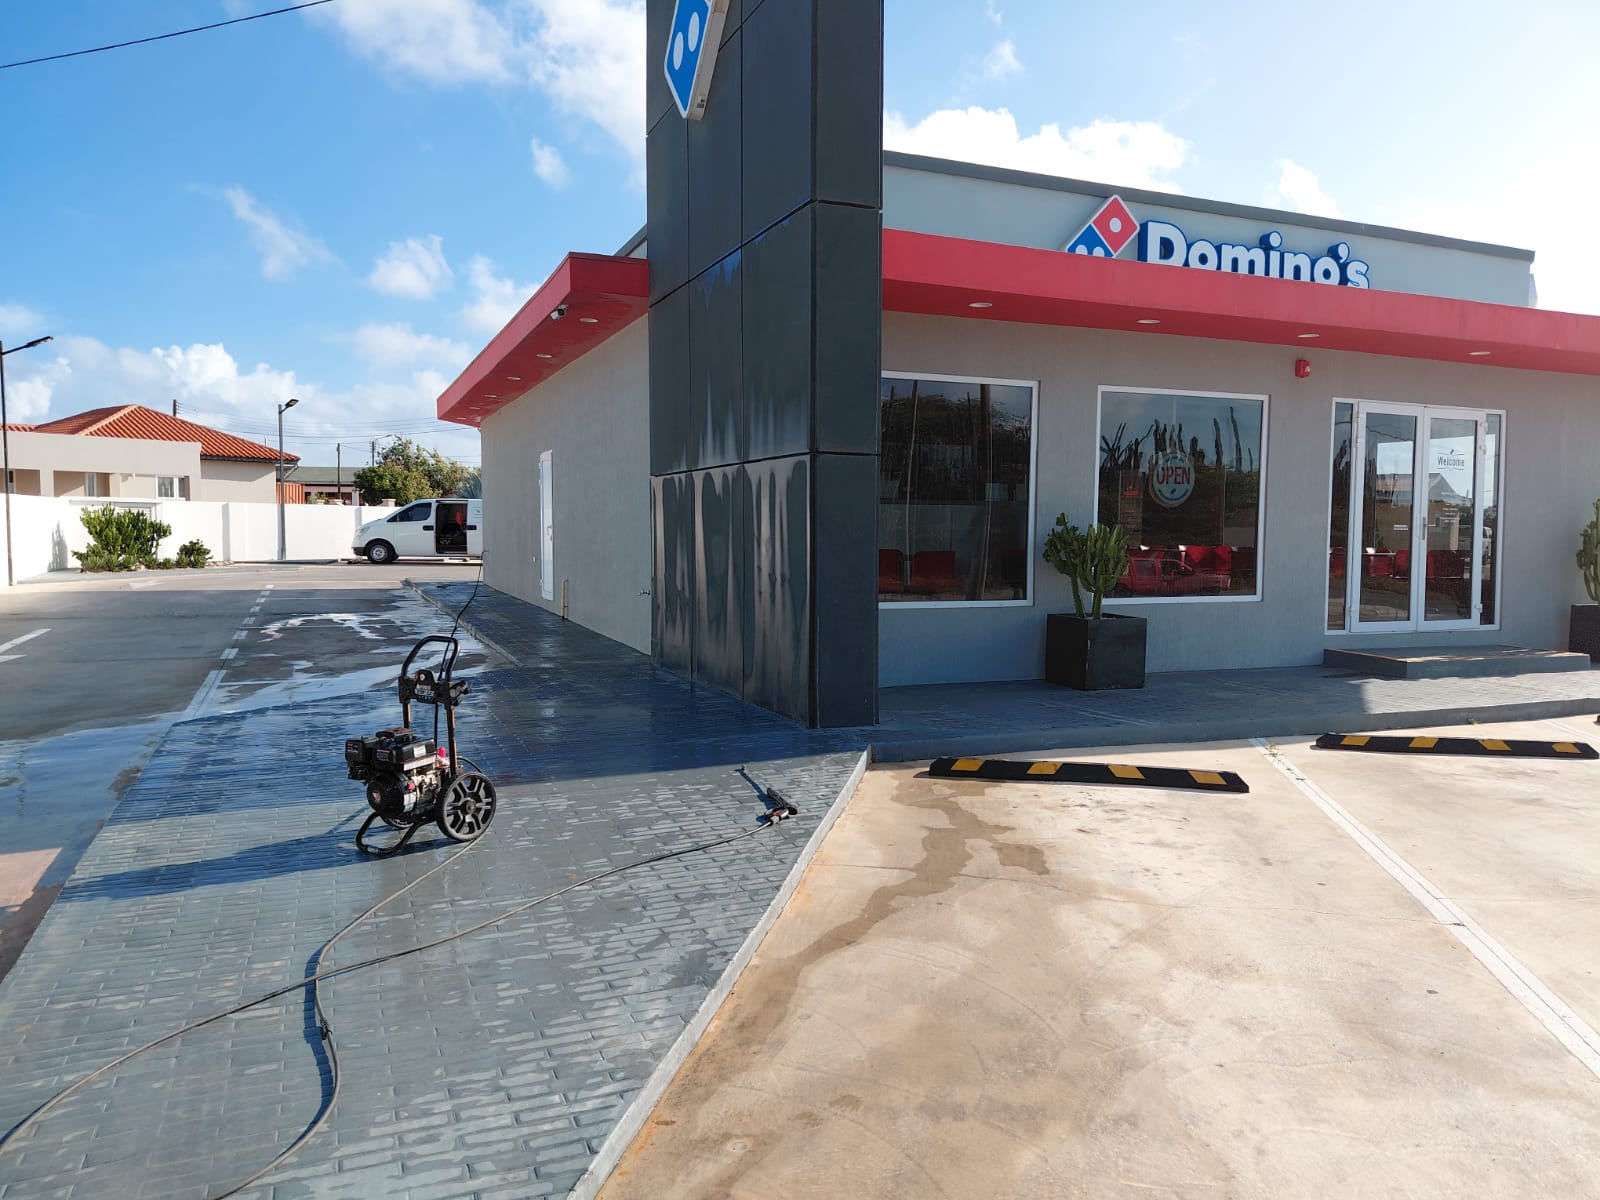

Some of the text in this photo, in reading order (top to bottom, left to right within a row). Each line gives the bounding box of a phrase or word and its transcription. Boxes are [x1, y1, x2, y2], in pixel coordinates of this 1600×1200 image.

[1139, 220, 1369, 289] Domino's
[1437, 455, 1465, 467] Welcome
[1156, 466, 1191, 485] OPEN
